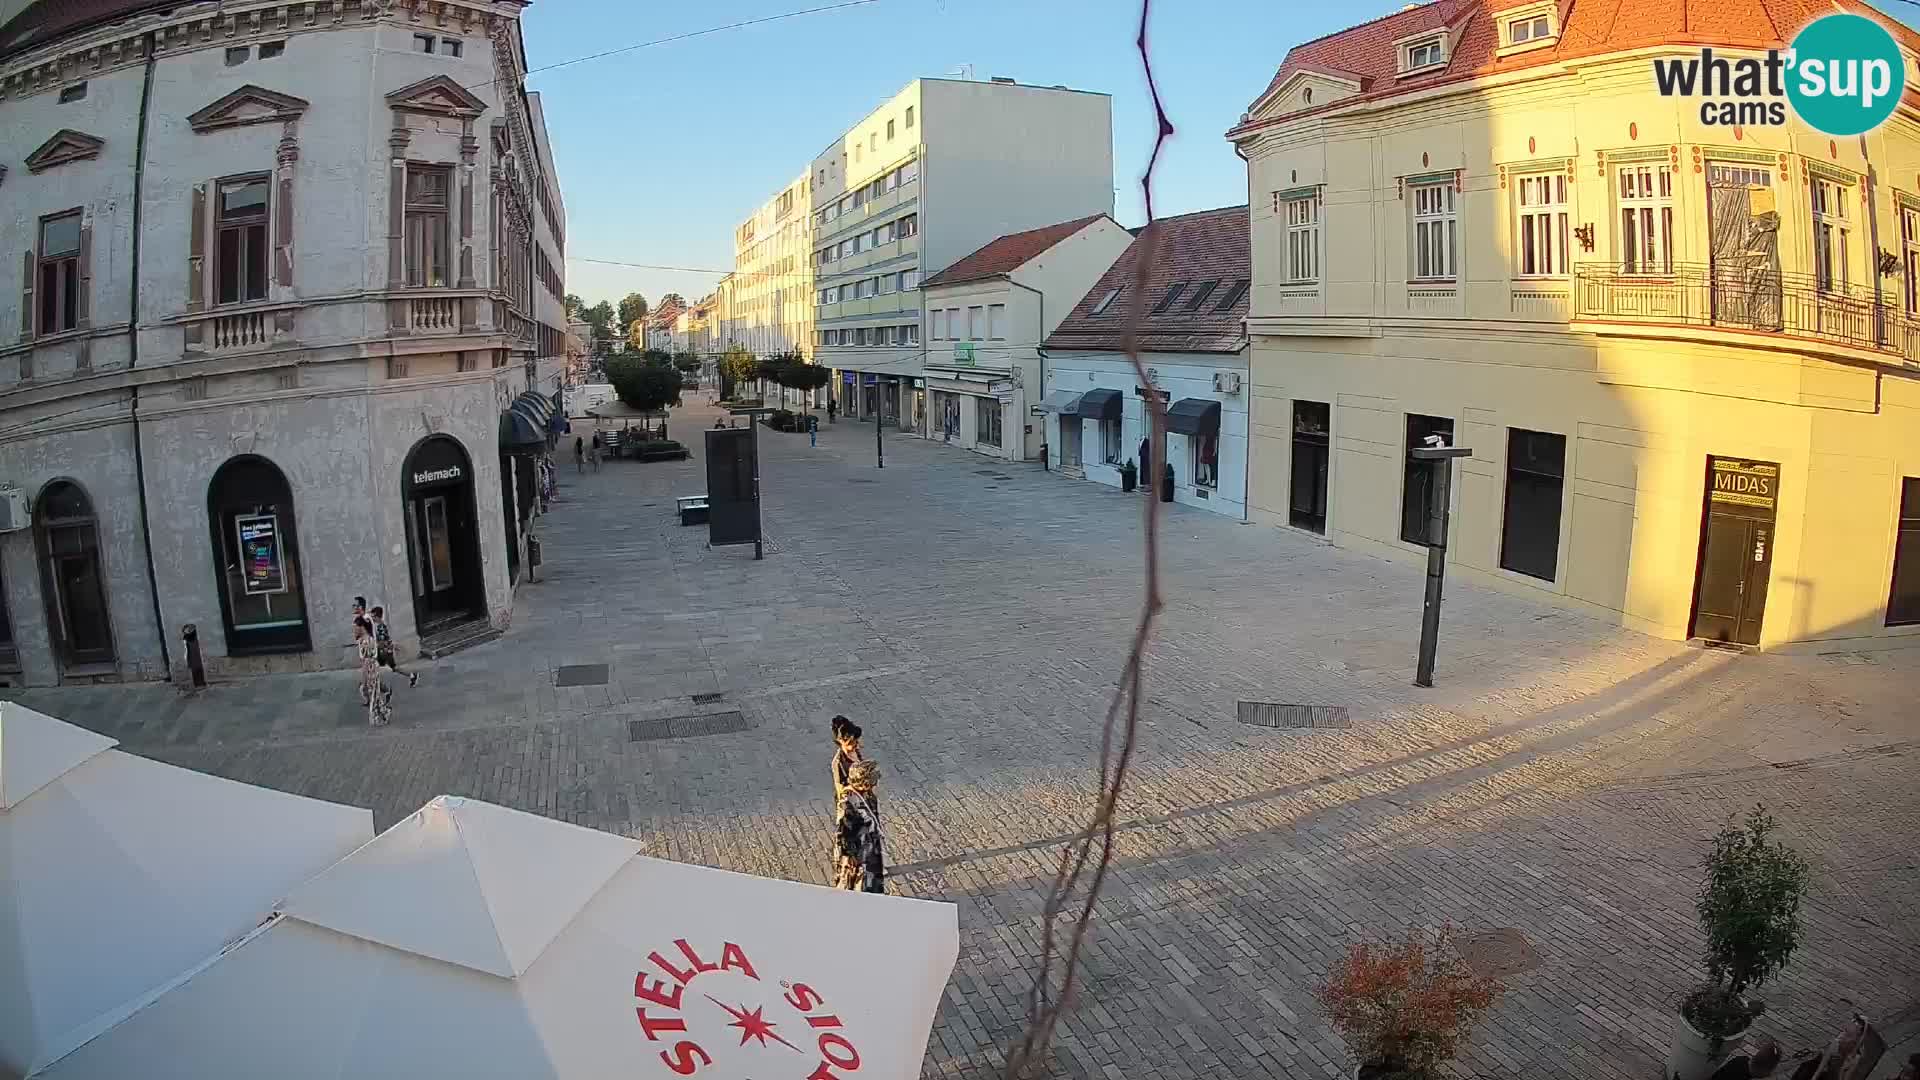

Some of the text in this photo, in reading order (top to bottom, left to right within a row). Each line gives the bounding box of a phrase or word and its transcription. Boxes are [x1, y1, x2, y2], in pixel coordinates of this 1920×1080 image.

[413, 465, 461, 484] telemach
[1714, 472, 1769, 494] MIDAS
[634, 938, 761, 1075] STELLA
